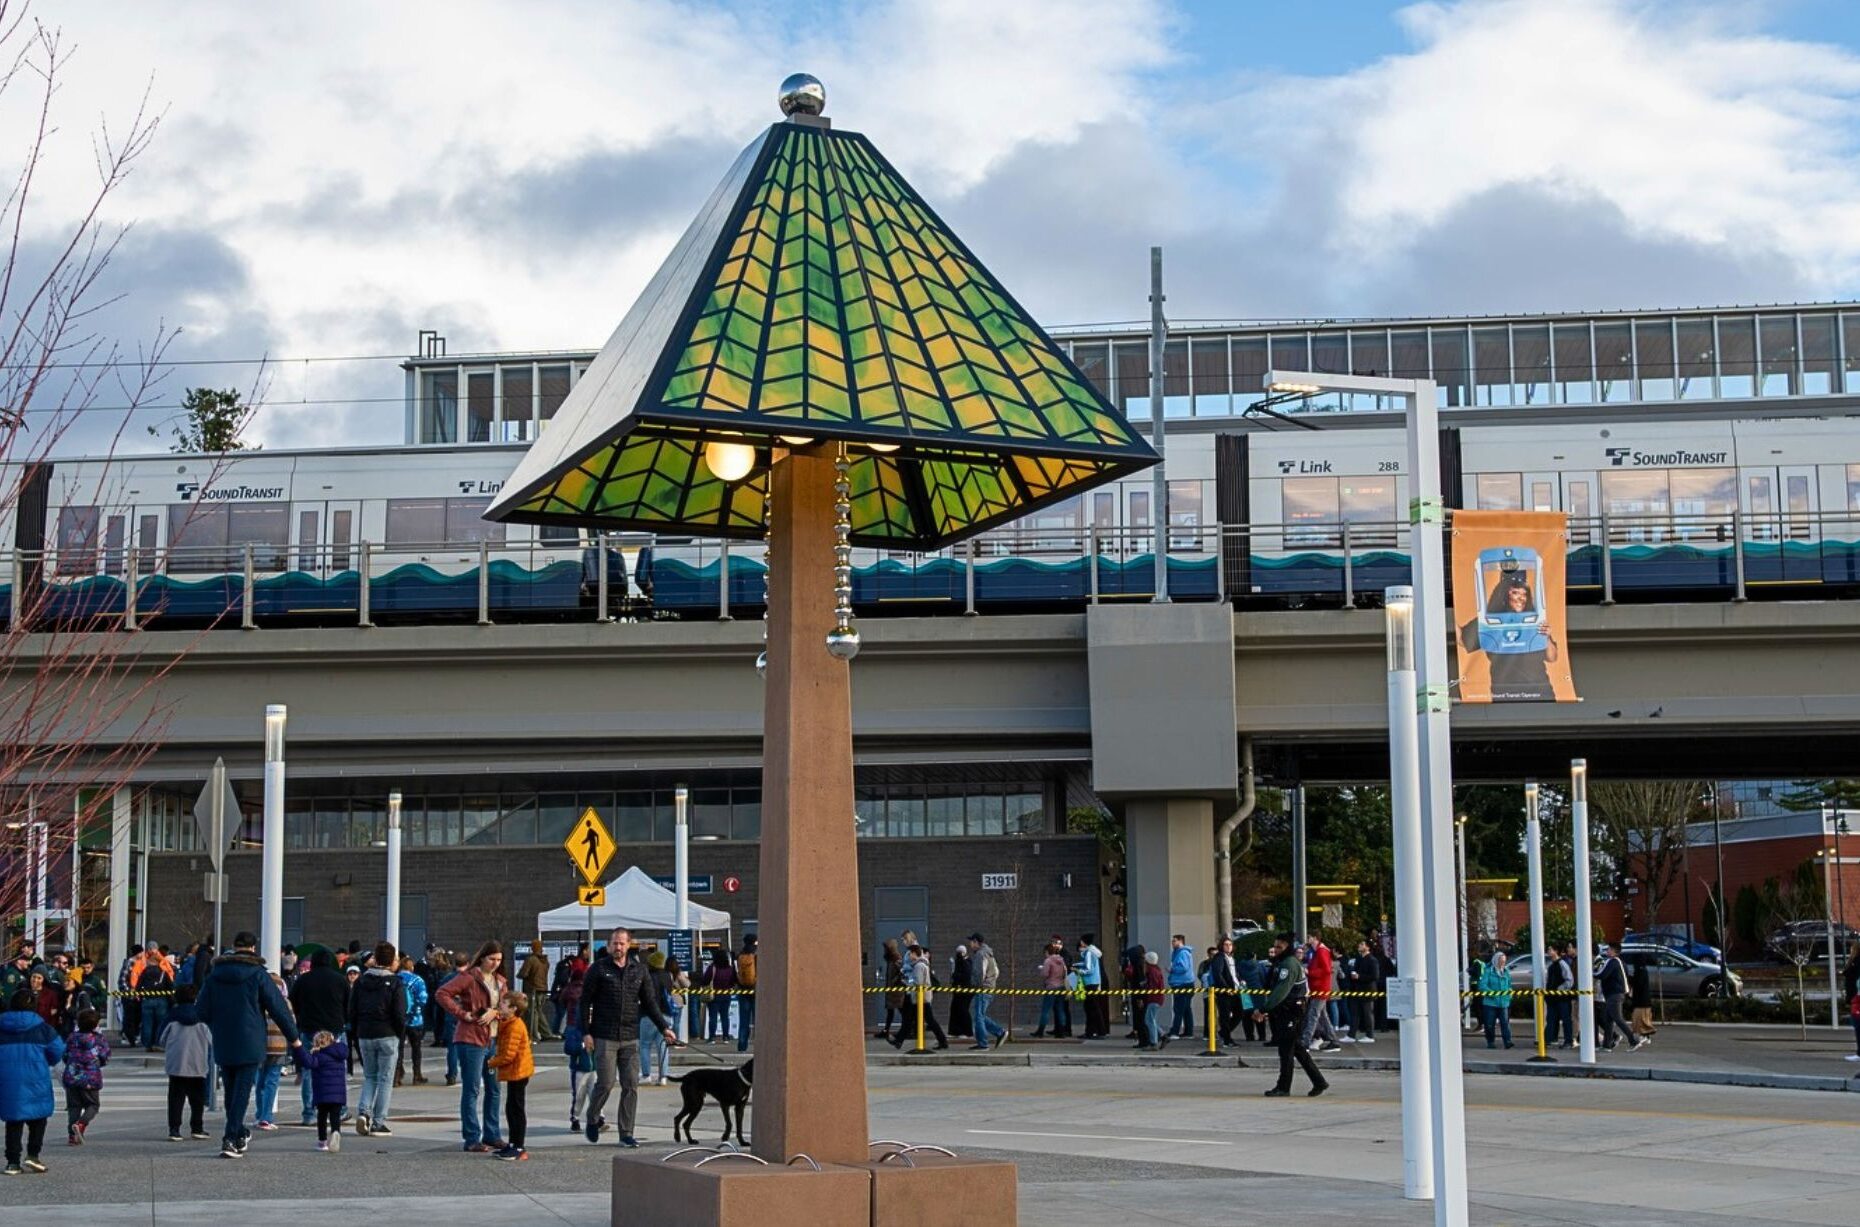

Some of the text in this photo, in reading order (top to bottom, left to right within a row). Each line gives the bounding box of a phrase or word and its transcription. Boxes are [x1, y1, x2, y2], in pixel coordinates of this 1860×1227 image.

[1300, 460, 1332, 473] Link
[1378, 461, 1400, 472] 288
[984, 875, 1016, 887] 31911
